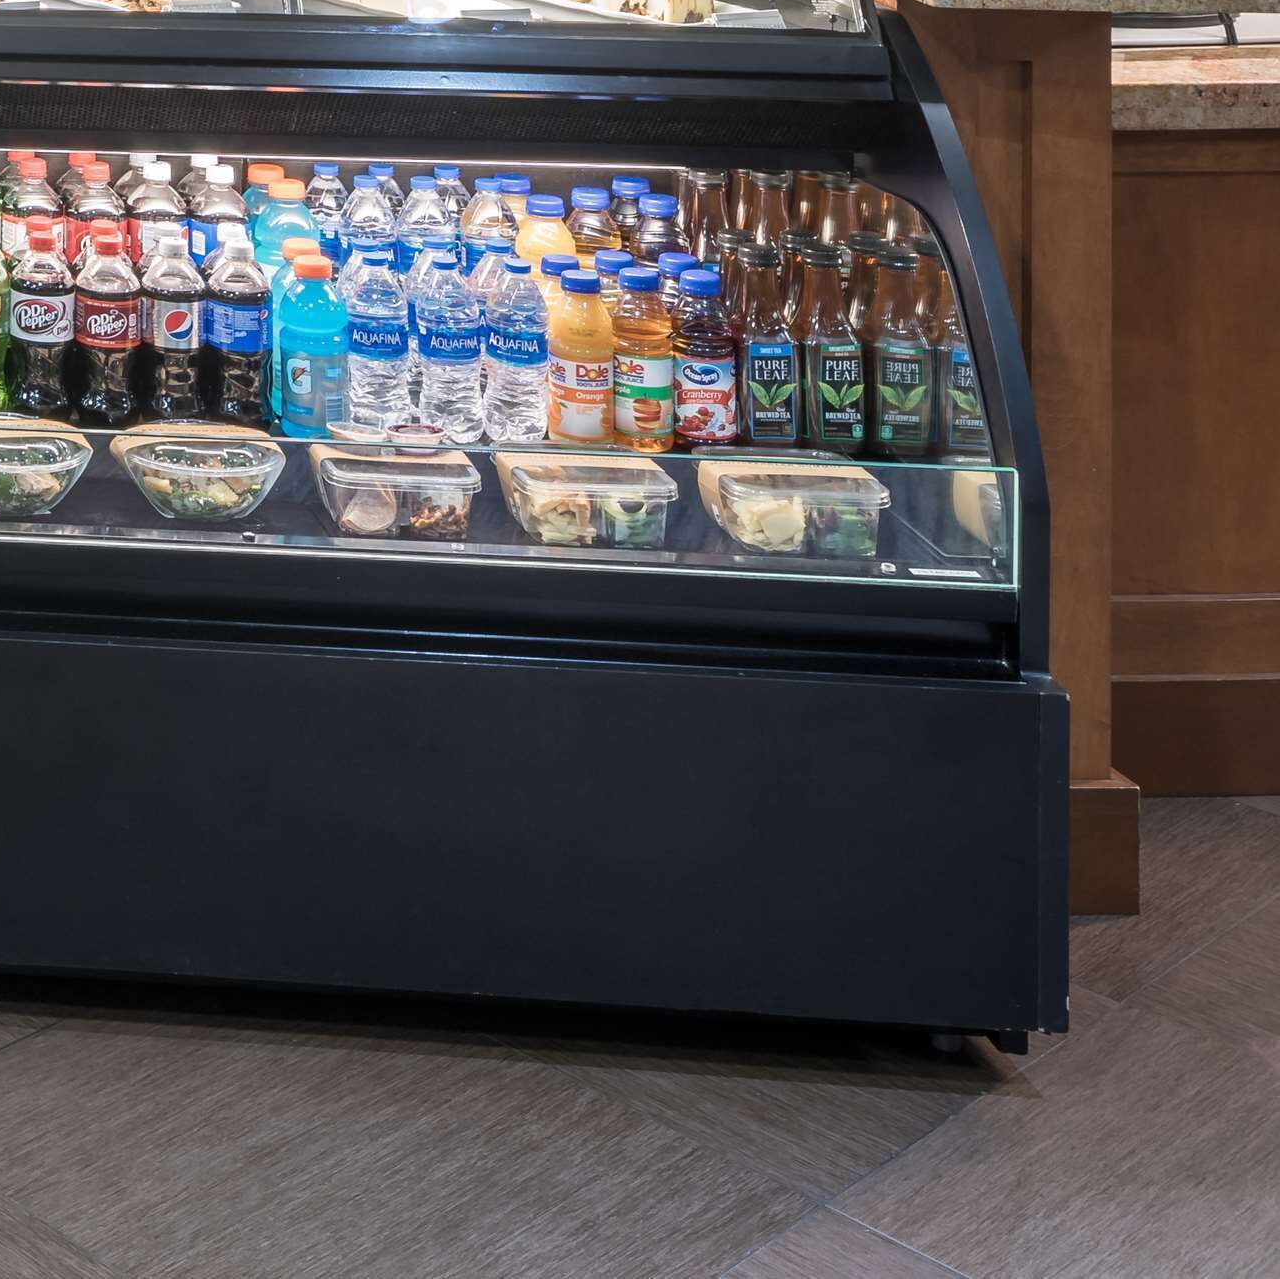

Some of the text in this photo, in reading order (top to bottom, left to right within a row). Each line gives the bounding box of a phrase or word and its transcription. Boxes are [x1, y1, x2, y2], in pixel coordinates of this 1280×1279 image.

[31, 304, 48, 317] Dr
[21, 306, 58, 330] Pepper
[101, 313, 116, 324] Dr
[91, 314, 124, 336] Pepper
[352, 329, 402, 346] AQUAFINA
[489, 332, 539, 353] AQUAFINA
[430, 335, 479, 352] AQUAFINA
[754, 360, 788, 370] PURE
[826, 360, 859, 370] PURE
[576, 364, 609, 380] Dole
[755, 370, 788, 380] LEAF
[826, 371, 859, 380] LEAF
[614, 384, 631, 395] pple
[576, 391, 605, 401] Orange
[682, 390, 723, 401] Cranberry
